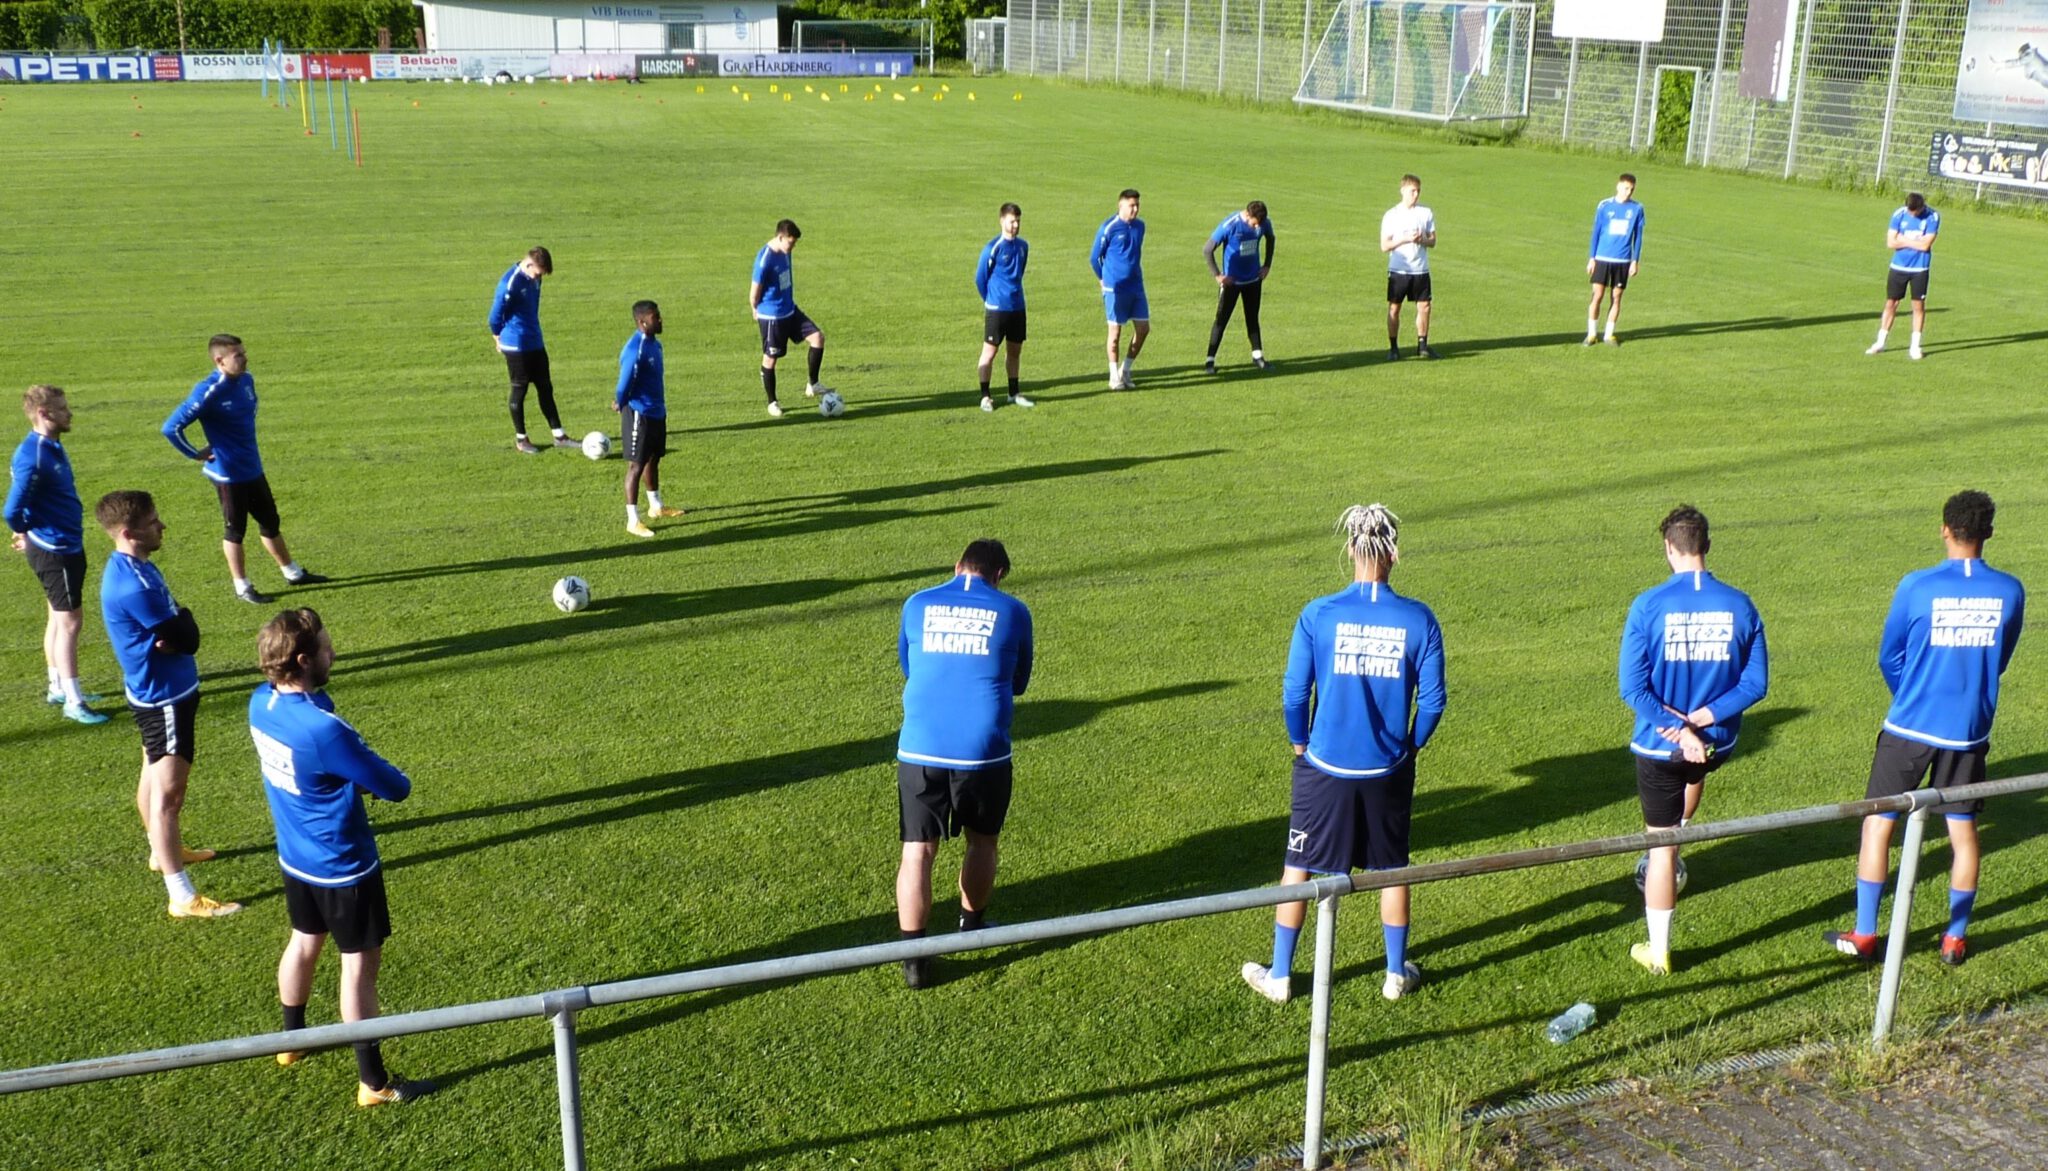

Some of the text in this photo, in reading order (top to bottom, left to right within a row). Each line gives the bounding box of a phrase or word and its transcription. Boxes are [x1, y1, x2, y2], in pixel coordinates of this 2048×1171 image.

[615, 6, 653, 17] Bretten
[19, 57, 150, 80] PETRI
[400, 56, 458, 65] Betsche
[641, 59, 684, 74] HARSCH
[1665, 642, 1730, 661] HACHTEL
[1334, 654, 1400, 677] HACHTEL
